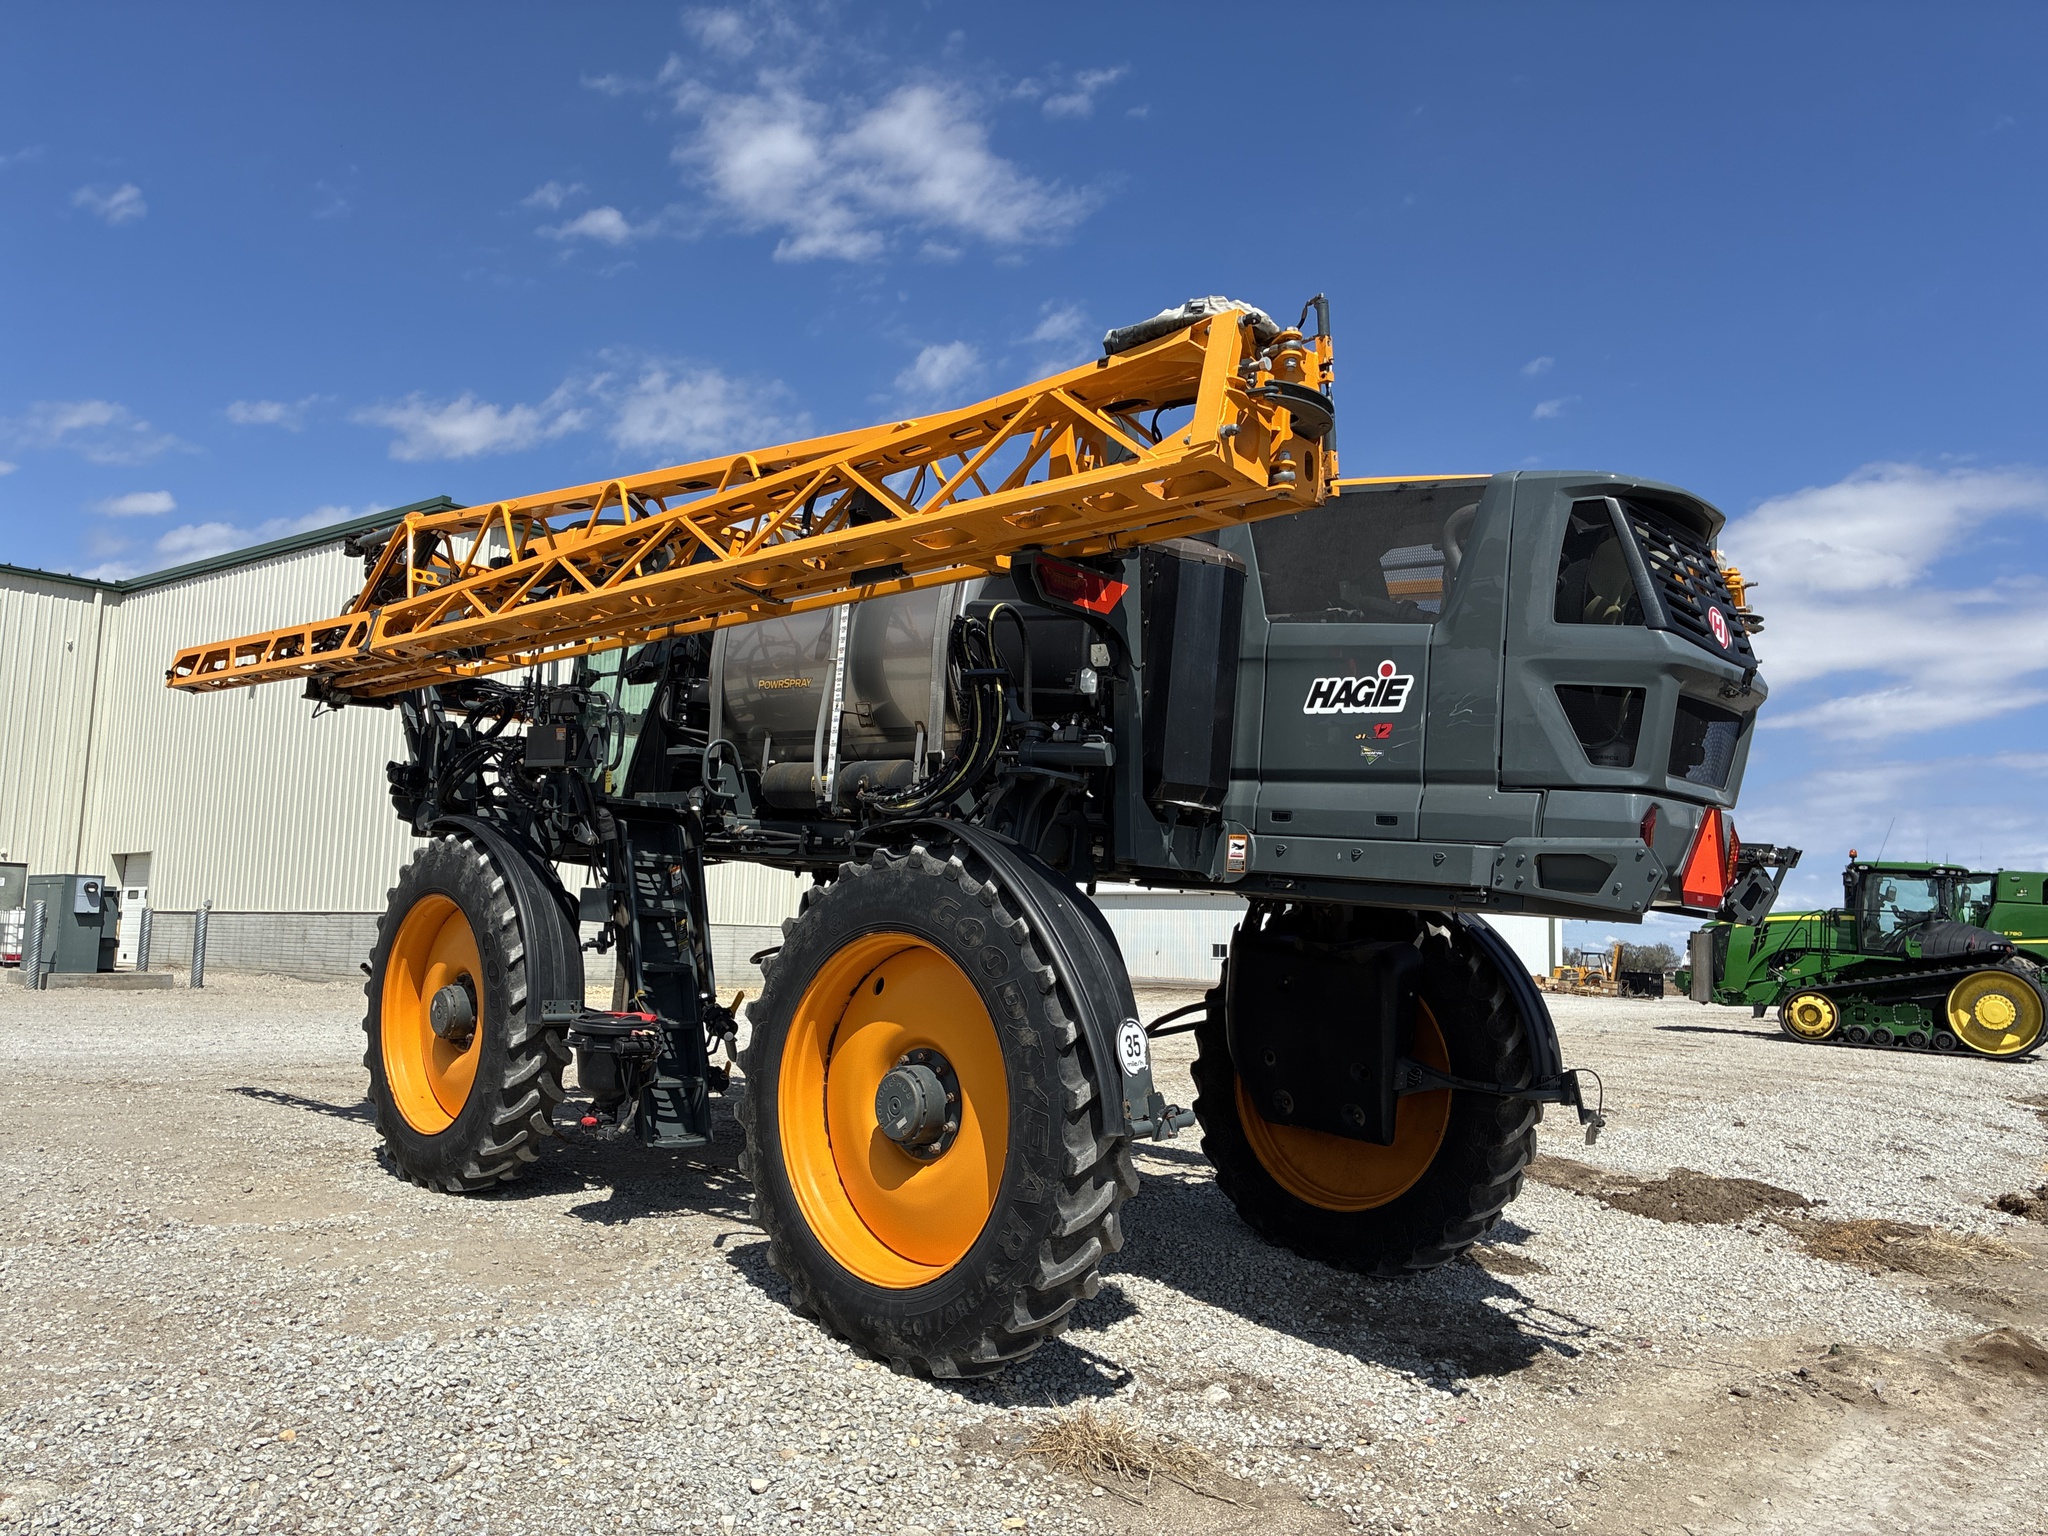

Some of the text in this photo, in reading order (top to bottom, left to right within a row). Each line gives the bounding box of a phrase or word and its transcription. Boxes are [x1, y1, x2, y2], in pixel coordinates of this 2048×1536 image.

[758, 677, 812, 690] POWRSPRAY
[1304, 662, 1413, 712] HAGIE
[1125, 1034, 1141, 1057] 35
[929, 896, 1049, 1261] GOODYEAR
